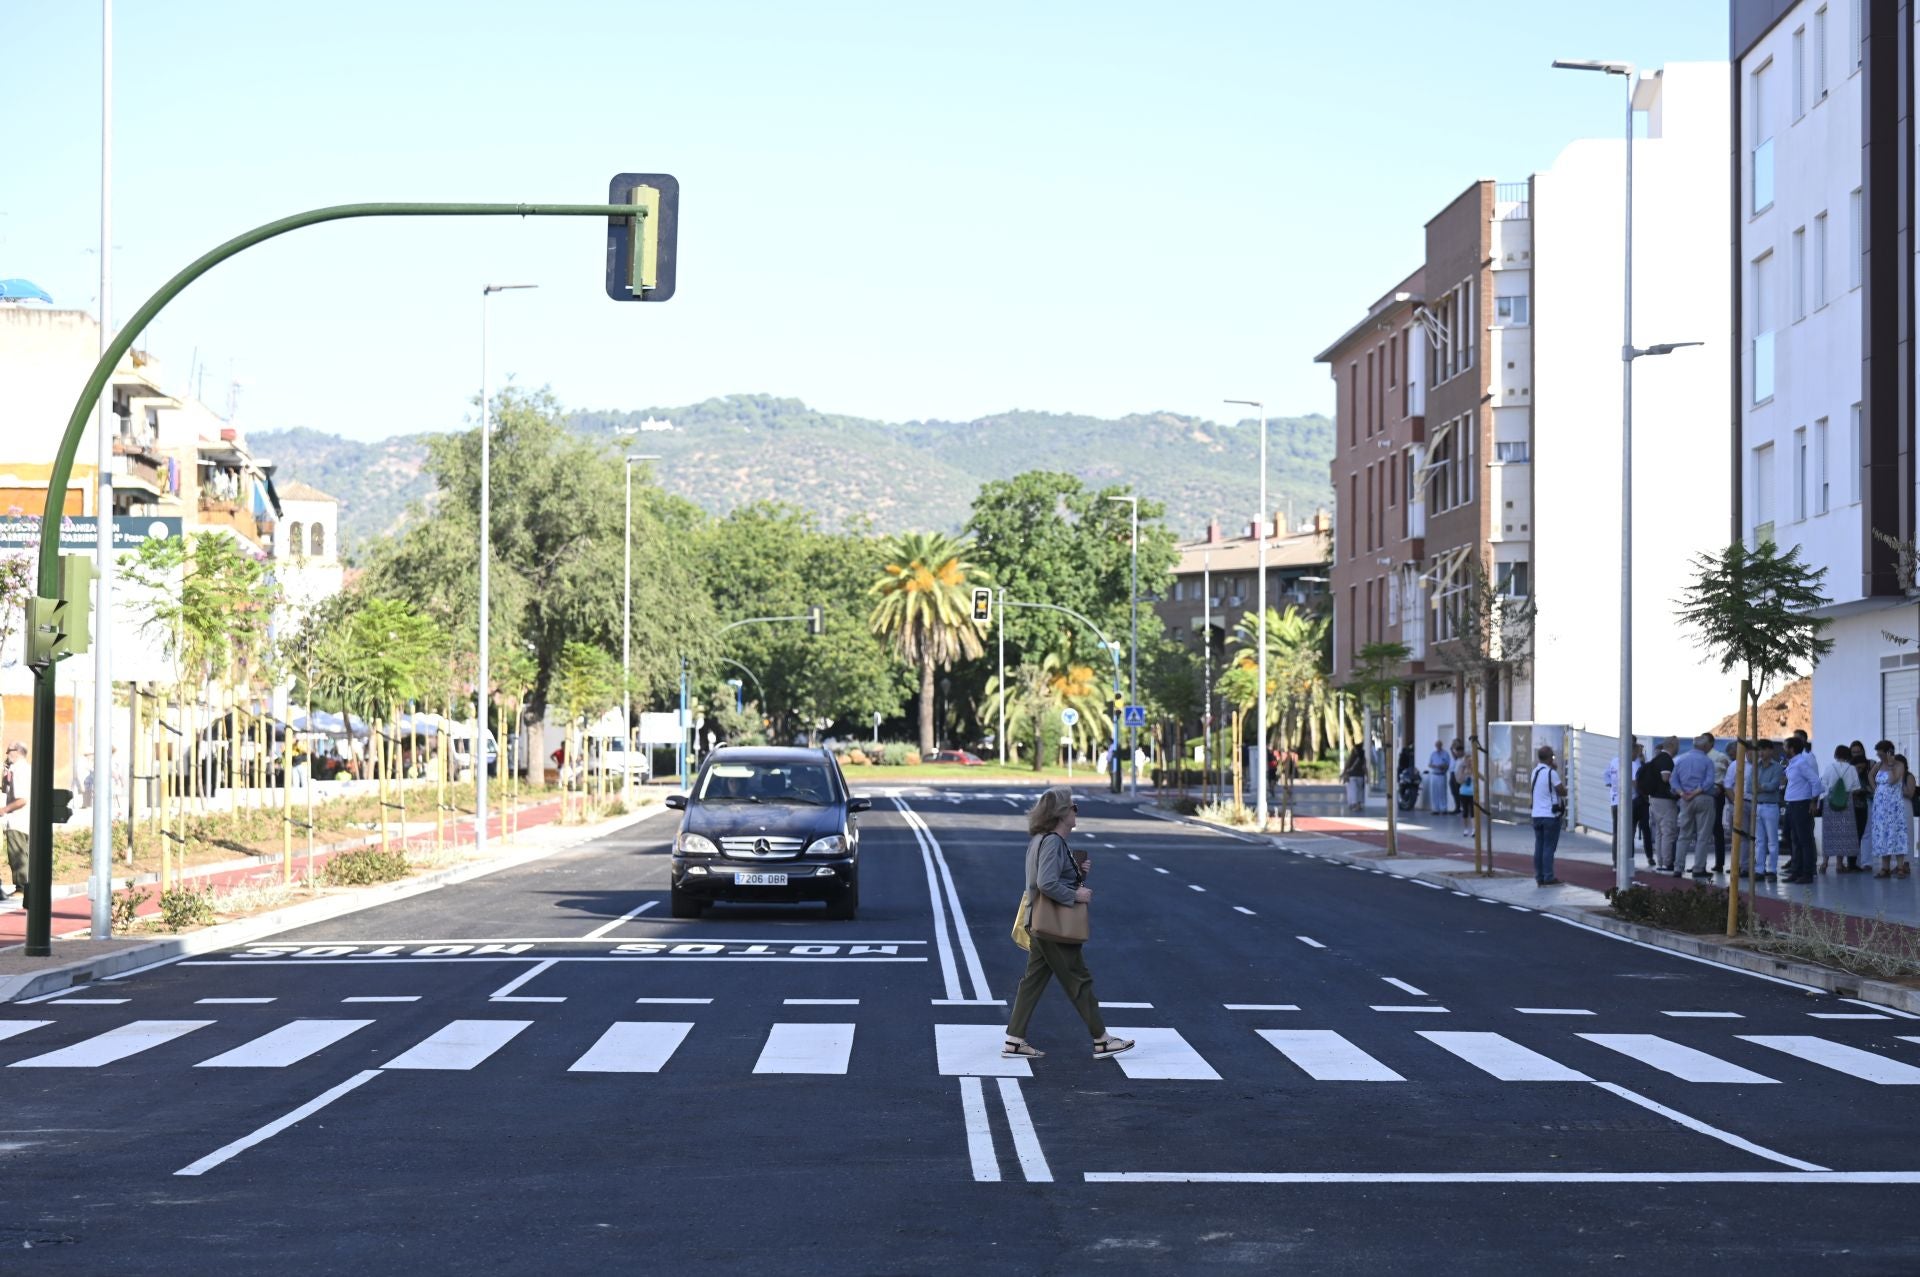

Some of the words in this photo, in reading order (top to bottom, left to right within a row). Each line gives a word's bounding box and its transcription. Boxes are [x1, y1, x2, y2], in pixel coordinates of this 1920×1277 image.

[740, 874, 764, 884] 7206
[767, 874, 786, 884] DBR
[230, 943, 535, 958] MOTOS
[609, 943, 899, 956] MOTOS
